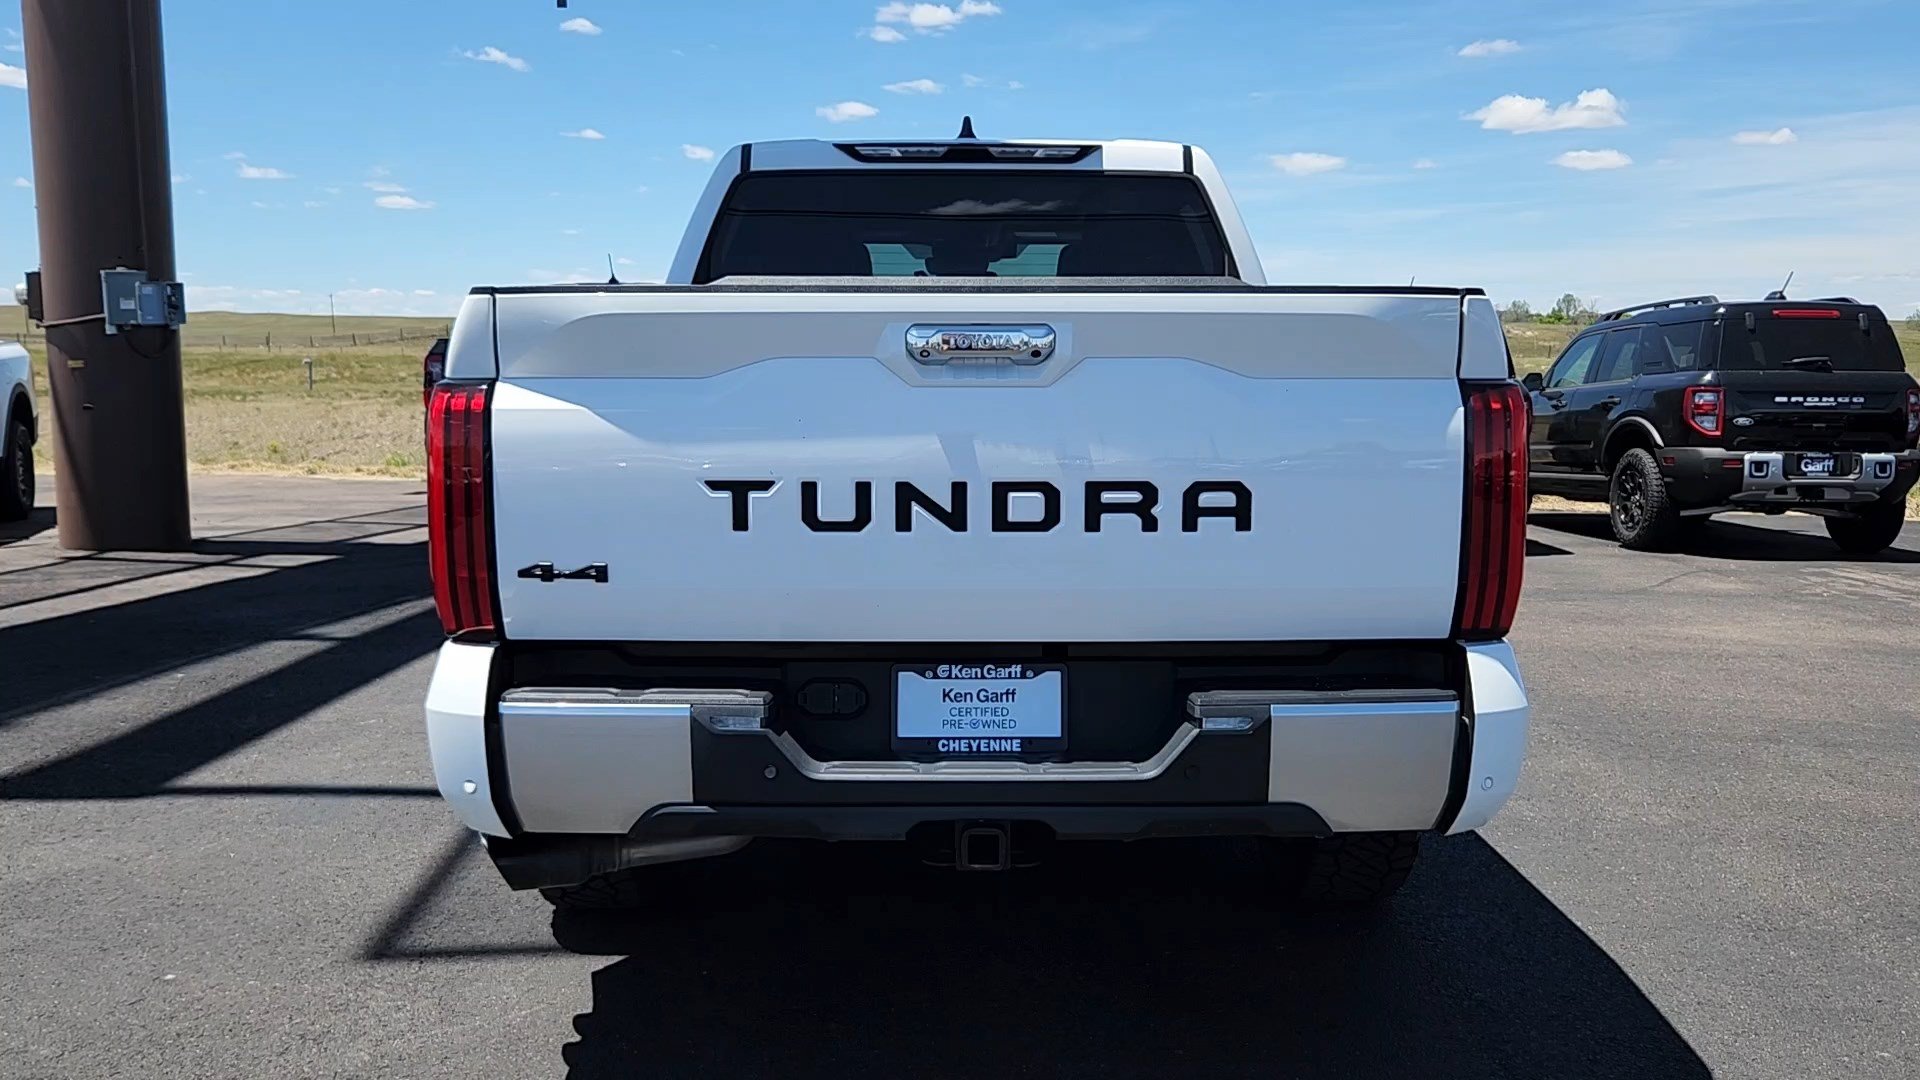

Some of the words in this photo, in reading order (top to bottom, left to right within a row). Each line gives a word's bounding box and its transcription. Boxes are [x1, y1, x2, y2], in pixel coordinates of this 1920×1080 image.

[946, 333, 1014, 349] TOYOTA
[1801, 459, 1834, 472] Garff
[702, 480, 1253, 533] TUNDRA
[951, 664, 982, 679] Ken
[983, 664, 1022, 679] Garff
[942, 688, 973, 703] Ken
[976, 688, 1017, 703] Garff
[949, 706, 1010, 718] CERTIFIED
[937, 738, 1022, 752] CHEYENNE
